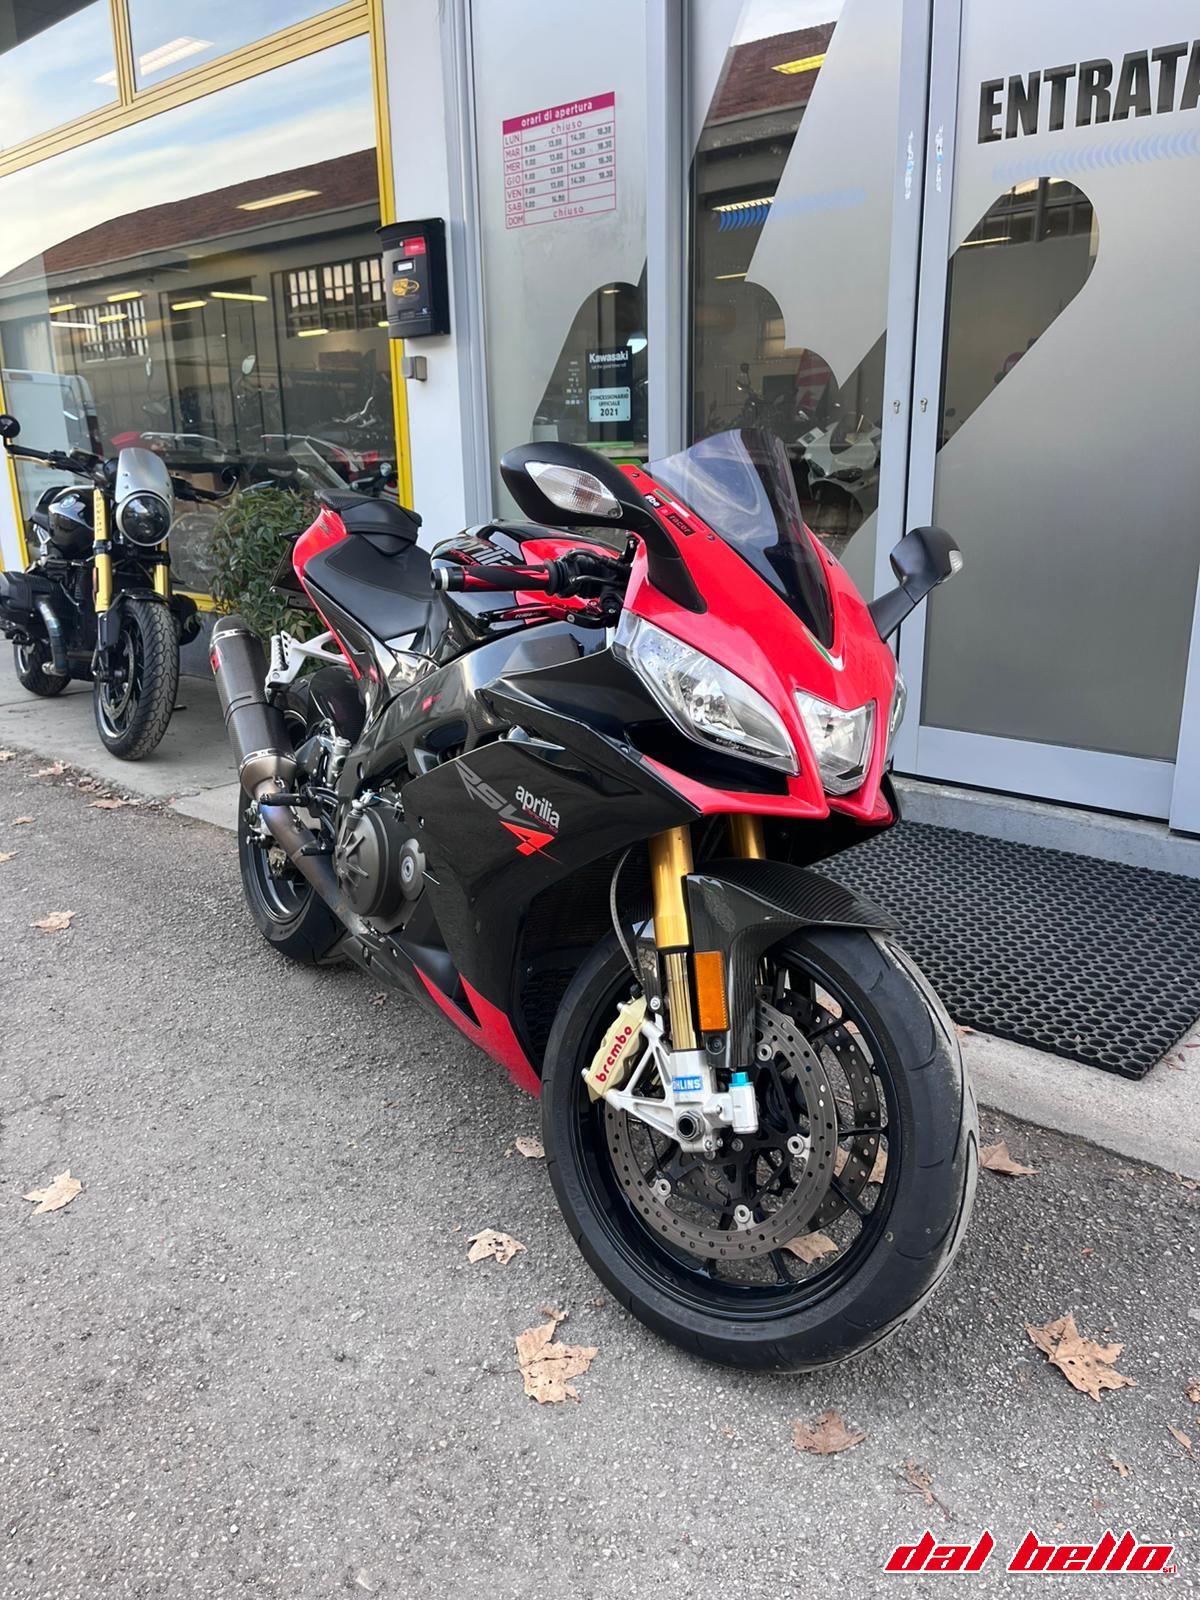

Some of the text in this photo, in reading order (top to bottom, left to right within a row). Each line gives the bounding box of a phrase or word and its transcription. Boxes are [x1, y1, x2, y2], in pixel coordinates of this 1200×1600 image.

[978, 39, 1200, 144] ENTRATA
[521, 101, 593, 127] orari di apertura
[504, 120, 582, 145] LUN chiuso
[505, 148, 520, 158] MAR
[506, 162, 521, 172] MER
[506, 175, 521, 185] GIO
[507, 189, 522, 199] VEN
[508, 202, 522, 212] SAB
[508, 205, 584, 225] DOM chiuso
[589, 350, 629, 363] Kawasaki
[600, 408, 619, 416] 2021
[515, 785, 561, 828] aprilia
[595, 1025, 632, 1082] brembo
